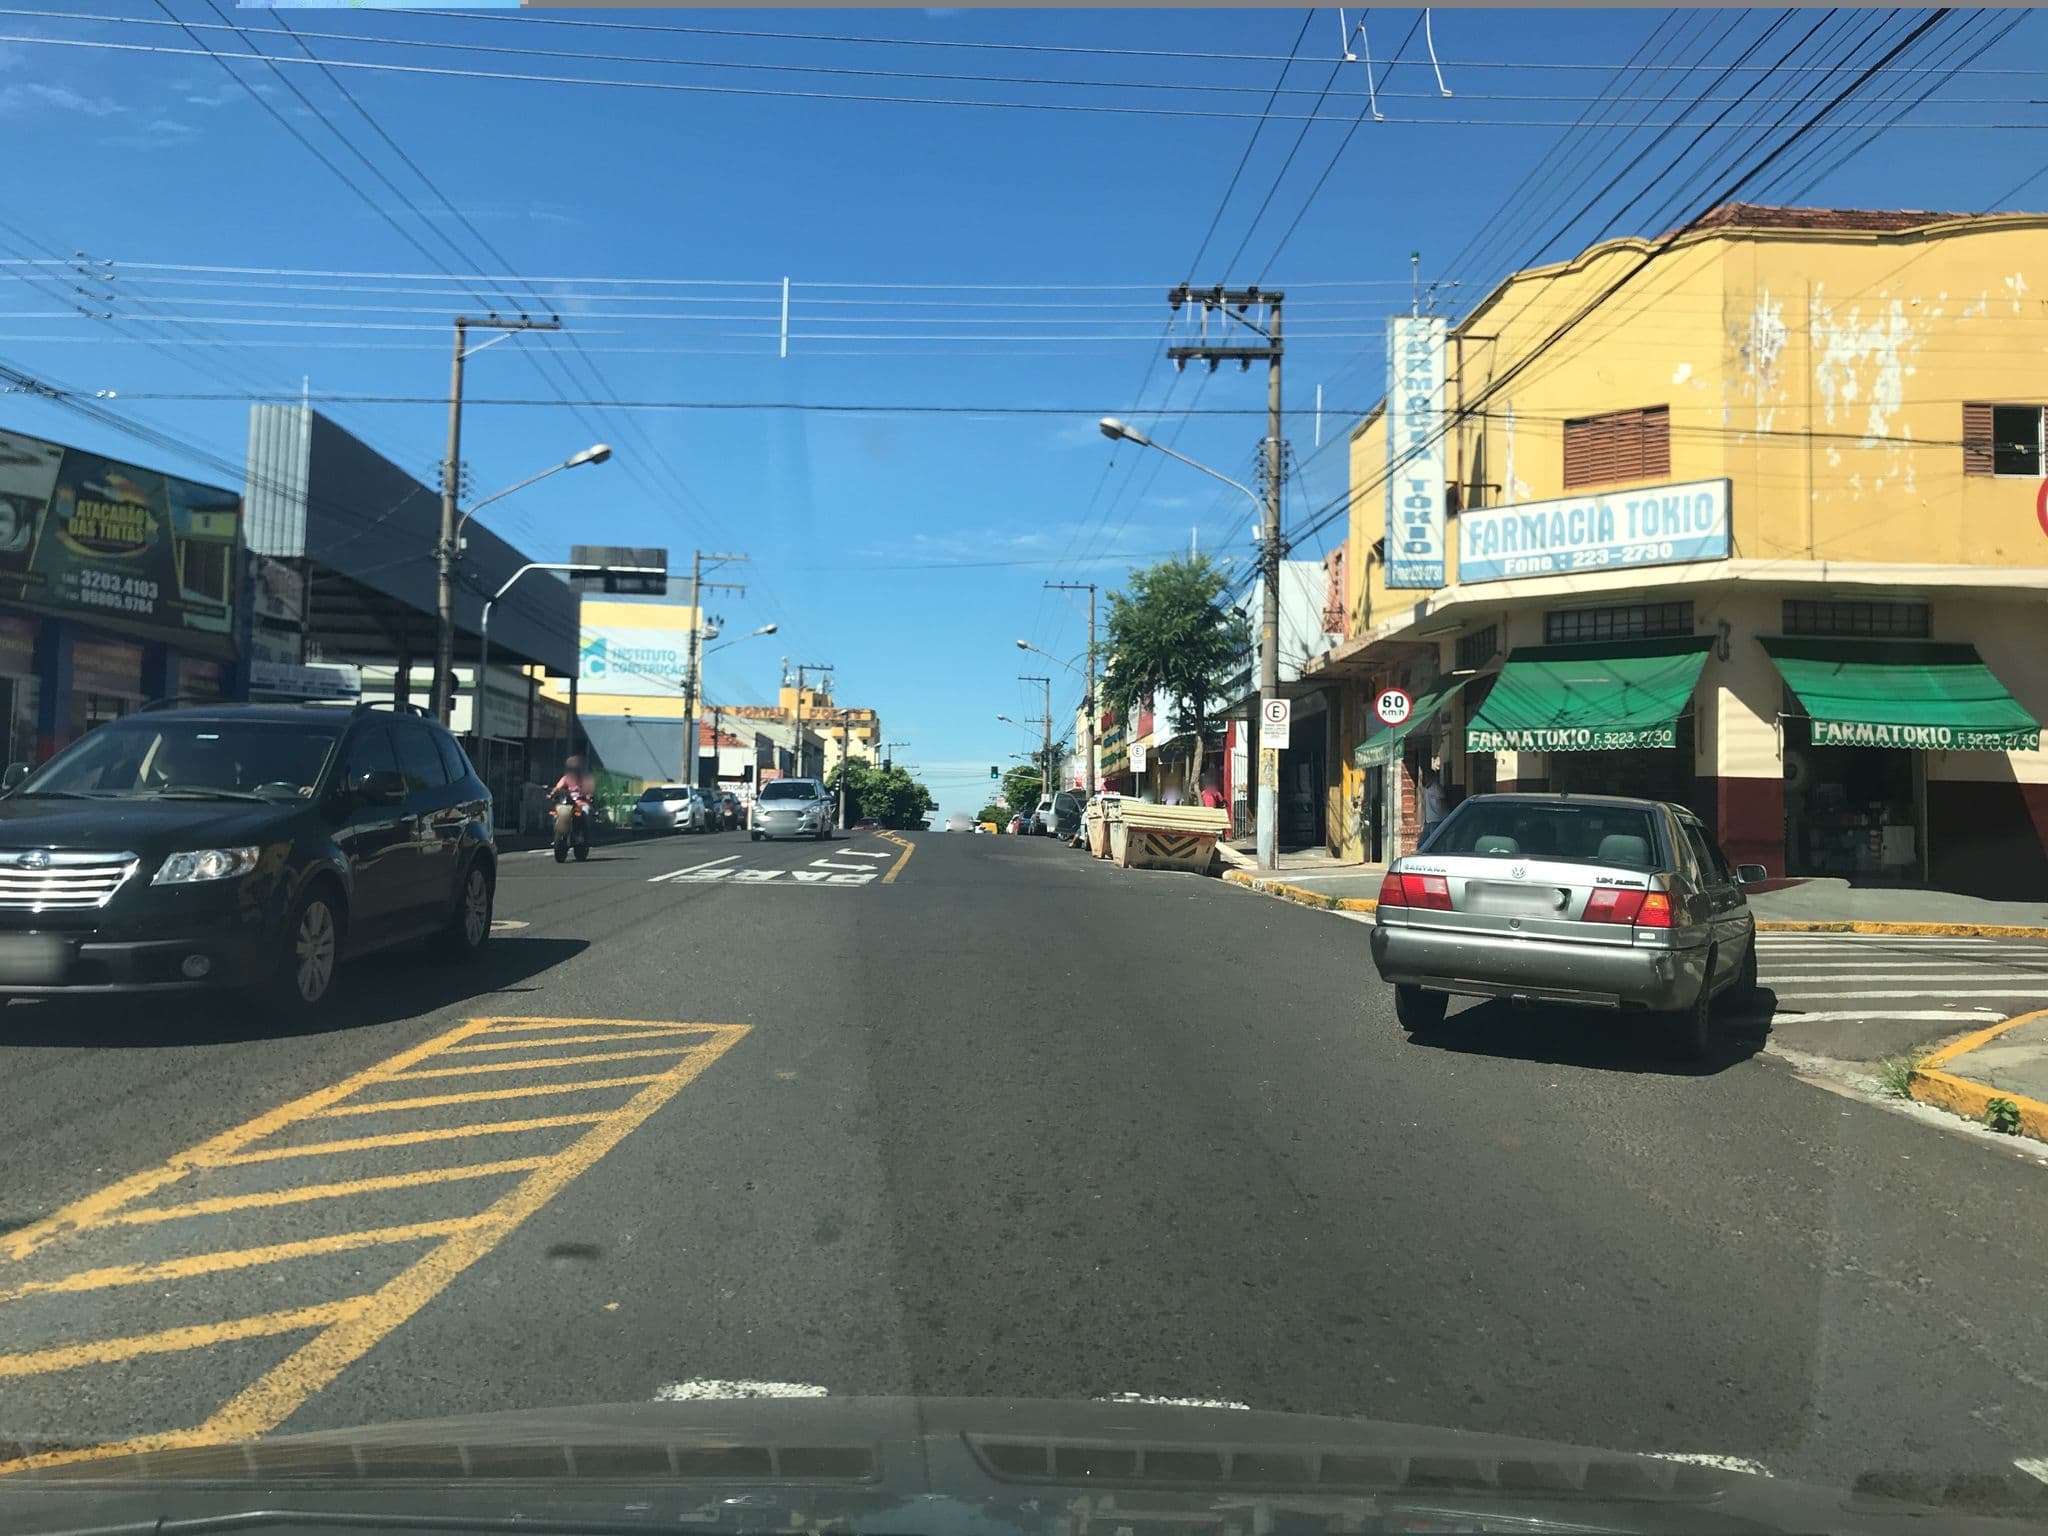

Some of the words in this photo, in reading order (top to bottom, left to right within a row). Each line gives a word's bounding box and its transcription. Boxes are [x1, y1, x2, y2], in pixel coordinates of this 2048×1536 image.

[1572, 542, 1673, 567] 223-2730
[612, 648, 677, 661] INSTITUTO
[1382, 695, 1404, 708] 60
[1272, 705, 1280, 718] E
[1468, 729, 1591, 747] FARMATOKIO
[1814, 721, 1951, 744] FARMATOKIO
